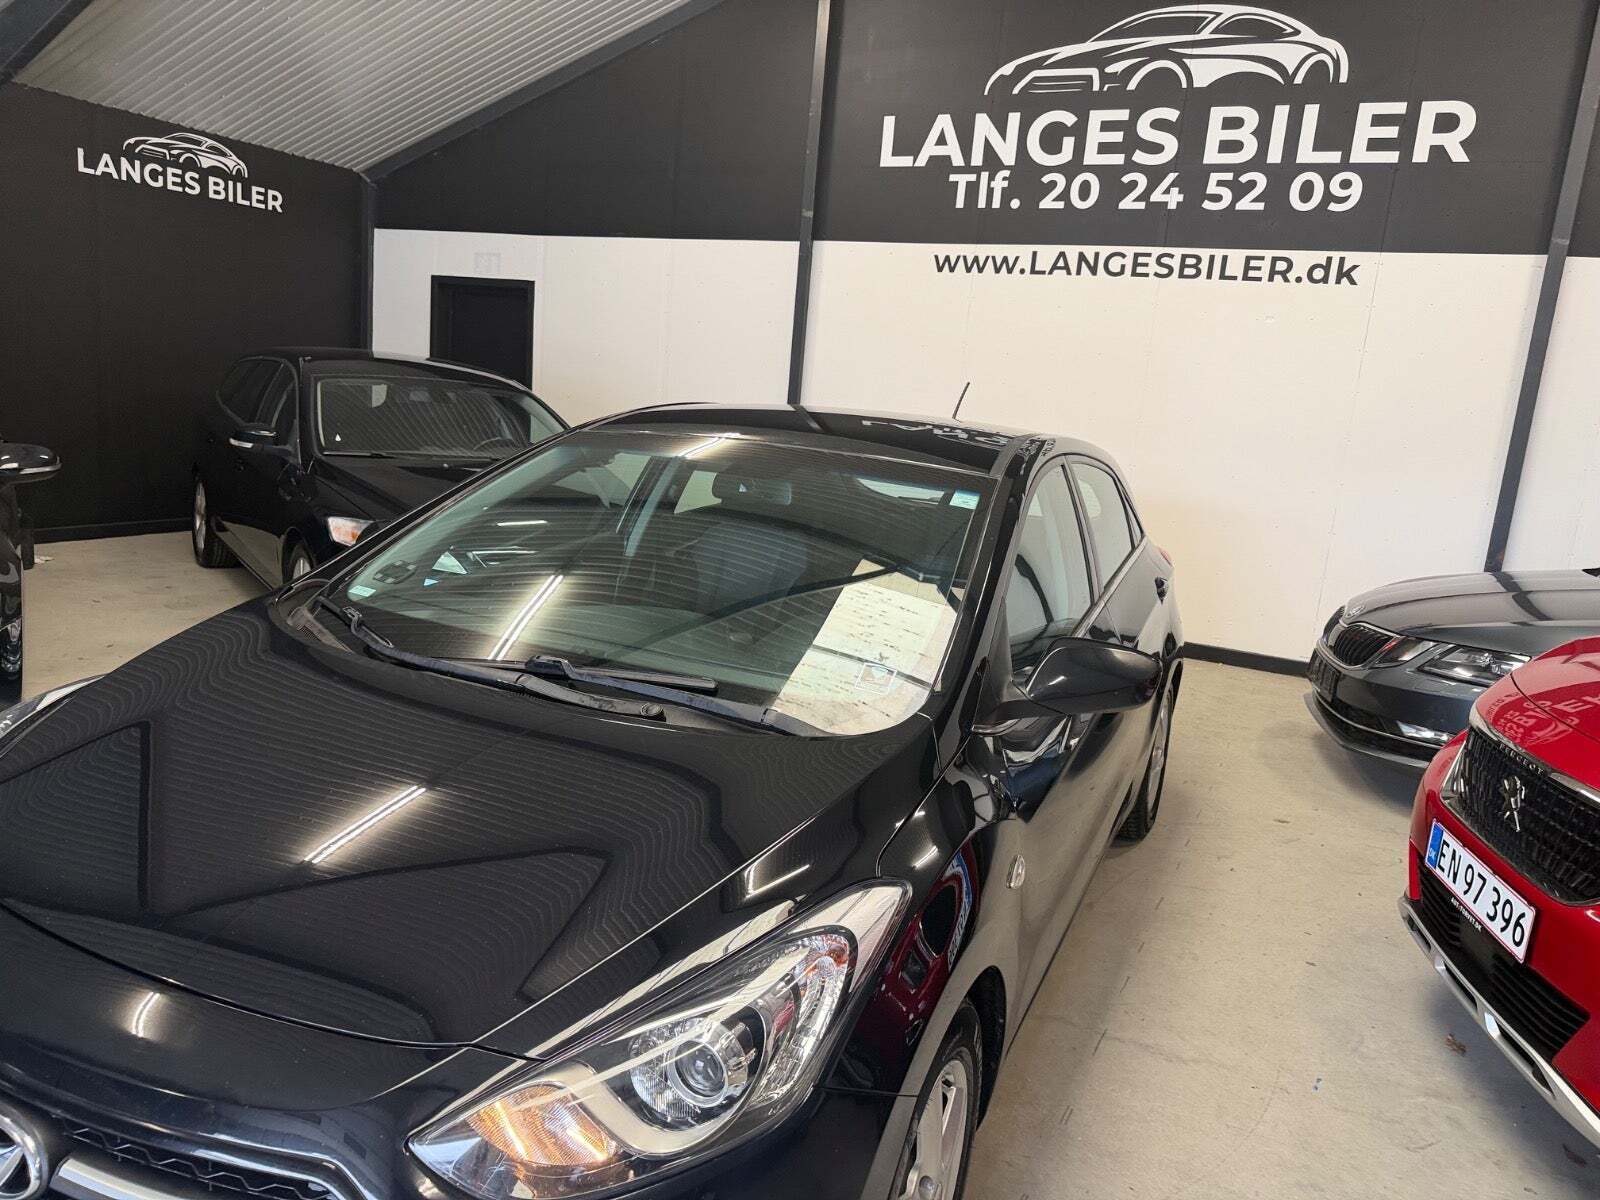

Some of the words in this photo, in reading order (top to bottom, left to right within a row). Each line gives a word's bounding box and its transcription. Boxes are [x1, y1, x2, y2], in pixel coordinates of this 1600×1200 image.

[879, 107, 1181, 168] LANGES
[1202, 100, 1478, 165] BILER
[77, 147, 201, 195] LANGES
[208, 175, 283, 213] BILER
[948, 170, 1021, 210] Tlf.
[1038, 172, 1101, 210] 20
[1117, 172, 1184, 211] 24
[1202, 171, 1267, 212] 52
[1288, 171, 1363, 213] 09
[933, 250, 1361, 286] www.LANGESBILER.dk
[1437, 839, 1462, 885] EN
[1463, 864, 1487, 905] 97
[1486, 886, 1526, 948] 396
